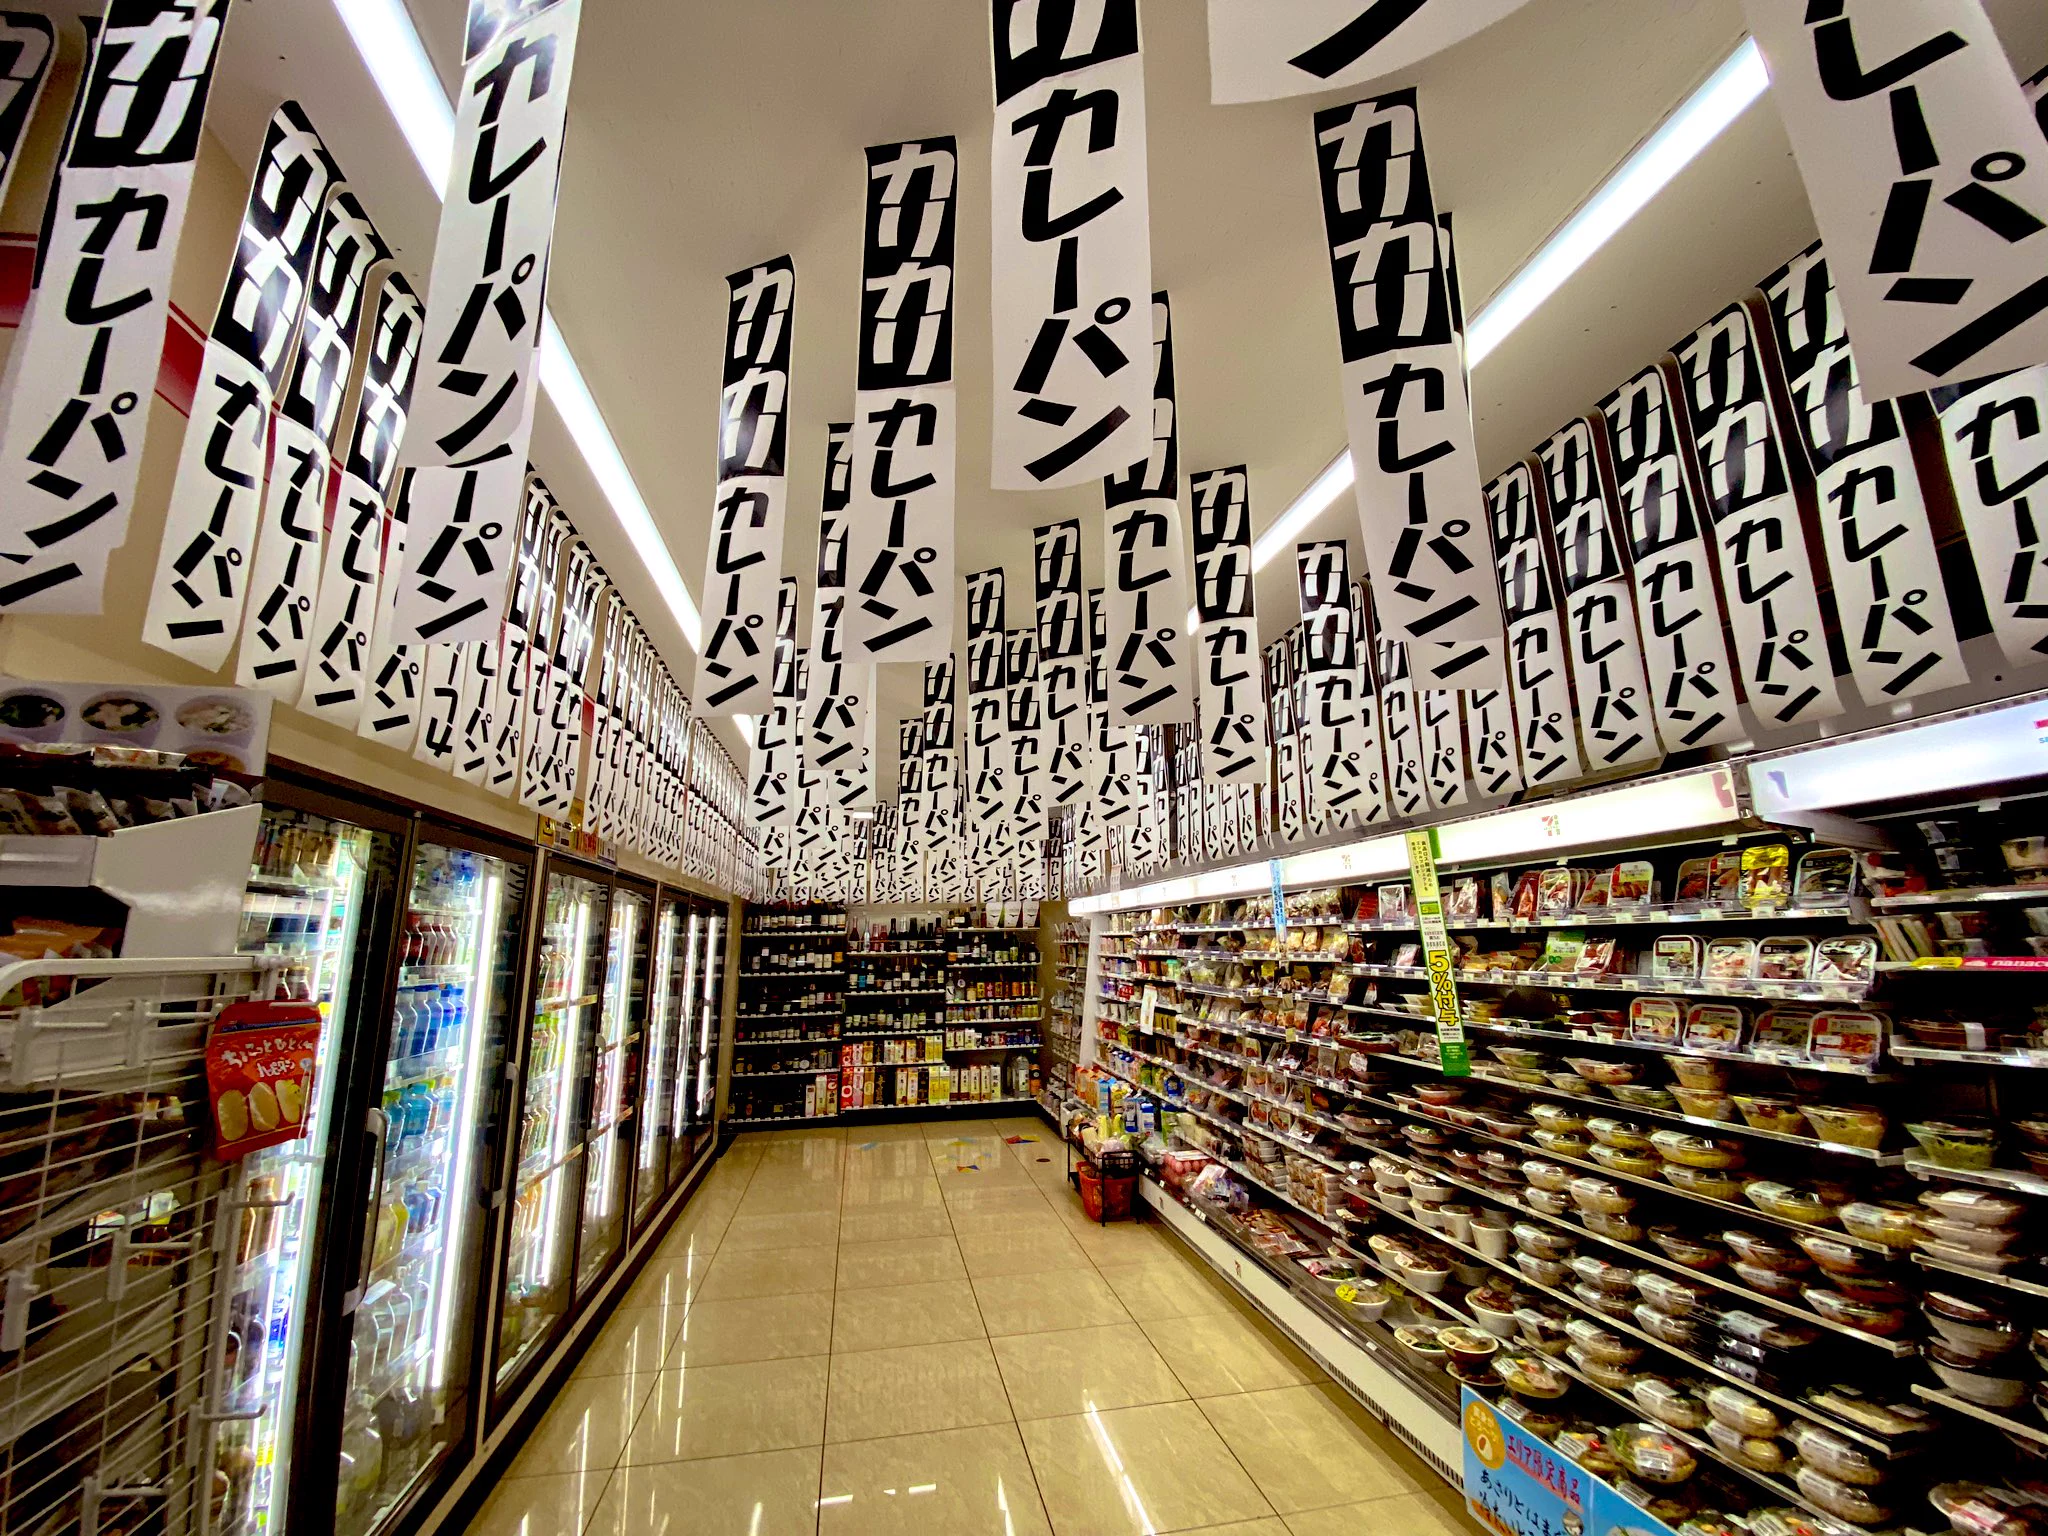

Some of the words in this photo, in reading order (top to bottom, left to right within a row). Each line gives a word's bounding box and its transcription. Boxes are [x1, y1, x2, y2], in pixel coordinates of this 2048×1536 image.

[705, 265, 793, 707] カリカリカレーパン
[859, 143, 955, 653] カリカリカレーパン
[1319, 101, 1480, 637] カリカリカレーパン
[1680, 311, 1820, 722] カリカリカレーパン
[1035, 526, 1084, 803] カリカリカレーパン
[1192, 470, 1256, 778] カリカリカレーパン
[1298, 543, 1362, 807] カリカリカレーパン
[1541, 422, 1643, 763] カリカリカレーパン
[1607, 372, 1724, 745] カリカリカレーパン
[1428, 949, 1459, 1026] 5%付与
